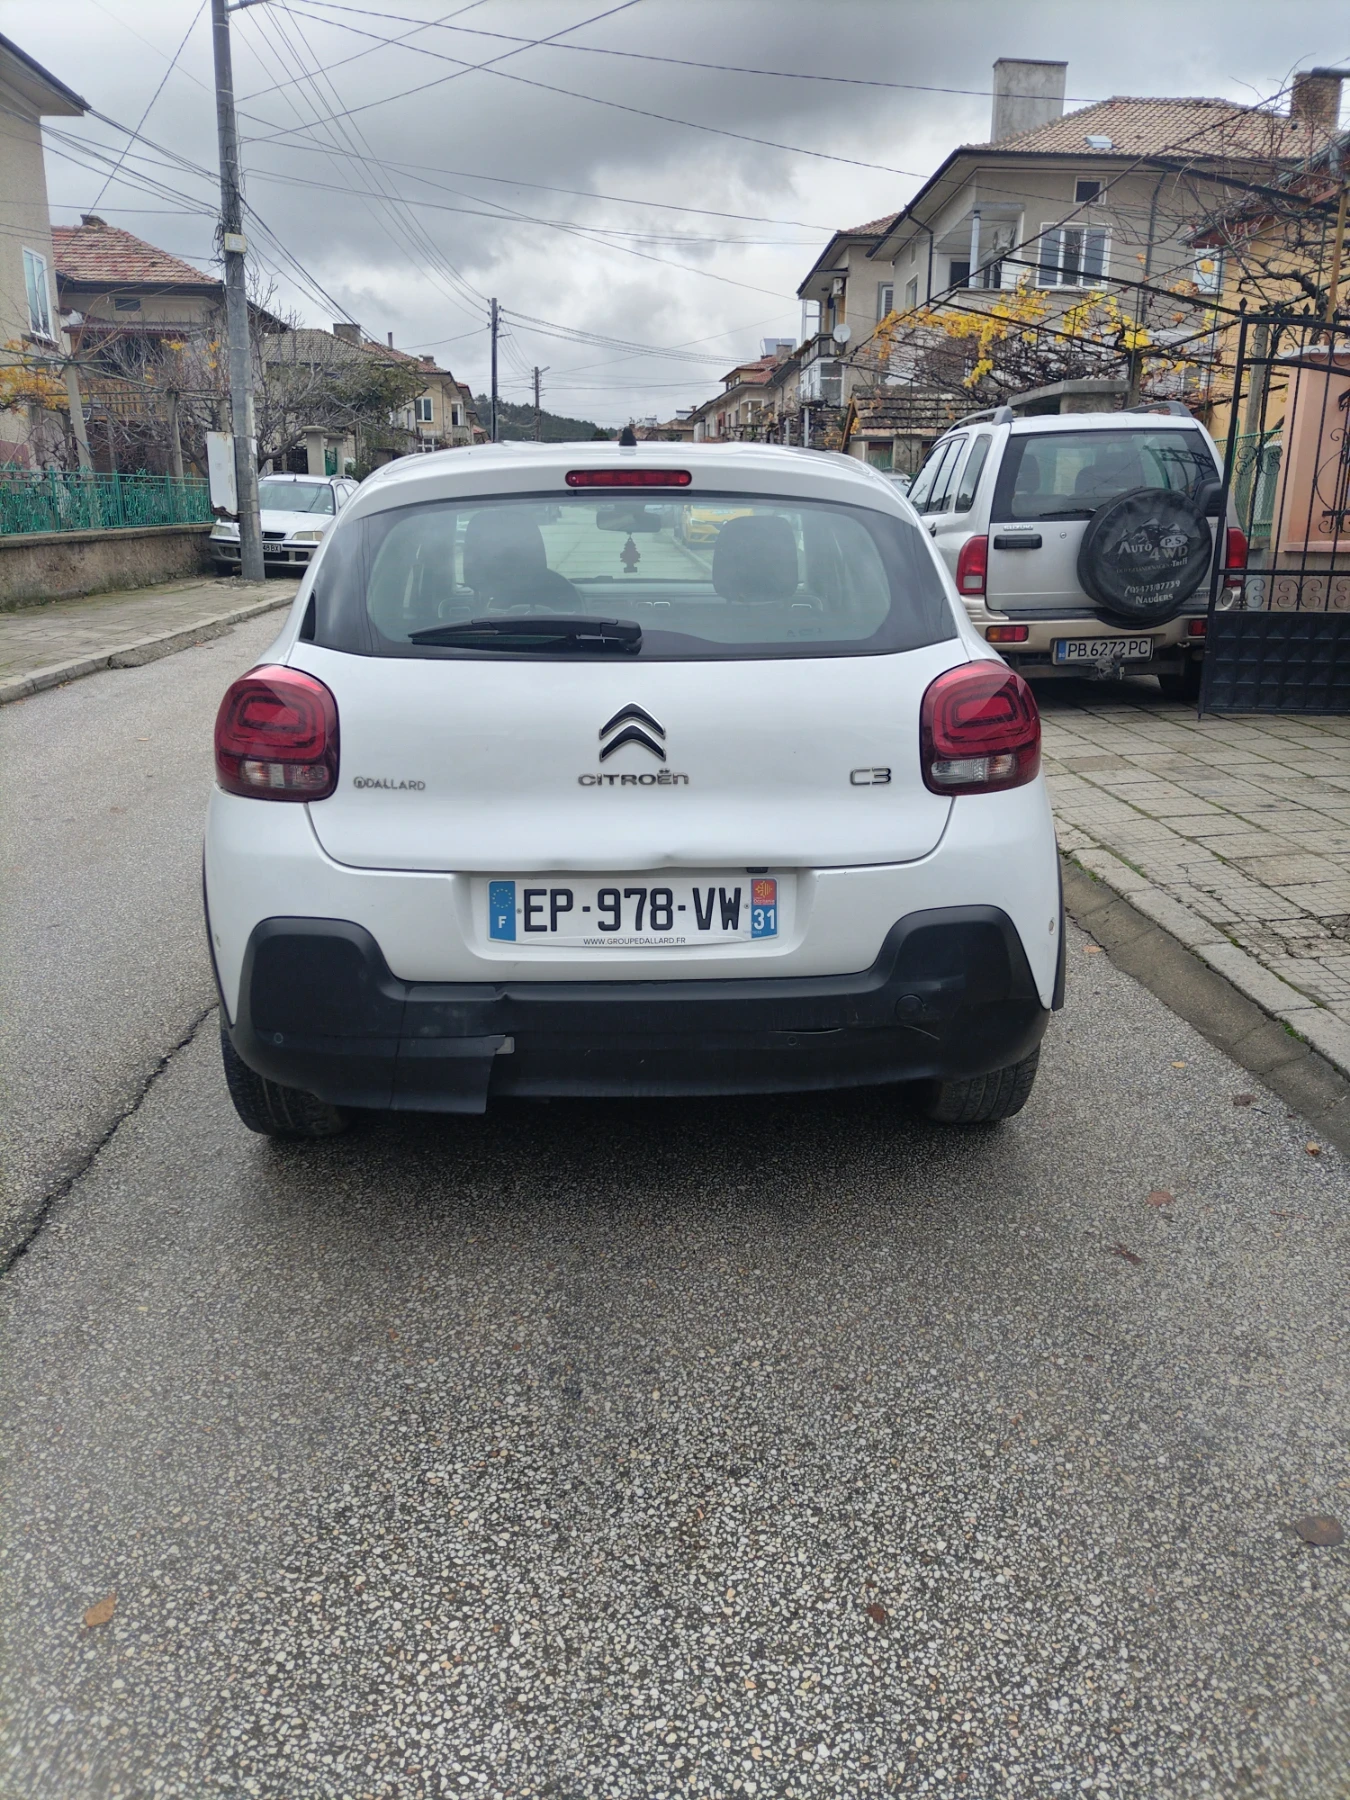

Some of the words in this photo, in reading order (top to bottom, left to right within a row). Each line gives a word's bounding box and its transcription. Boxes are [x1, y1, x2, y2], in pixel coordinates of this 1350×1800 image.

[850, 768, 891, 785] C3
[365, 778, 426, 791] DALLARD
[498, 916, 506, 929] F
[753, 908, 775, 930] 31
[583, 937, 686, 945] WWW.GROUPEDALLARD.FR
